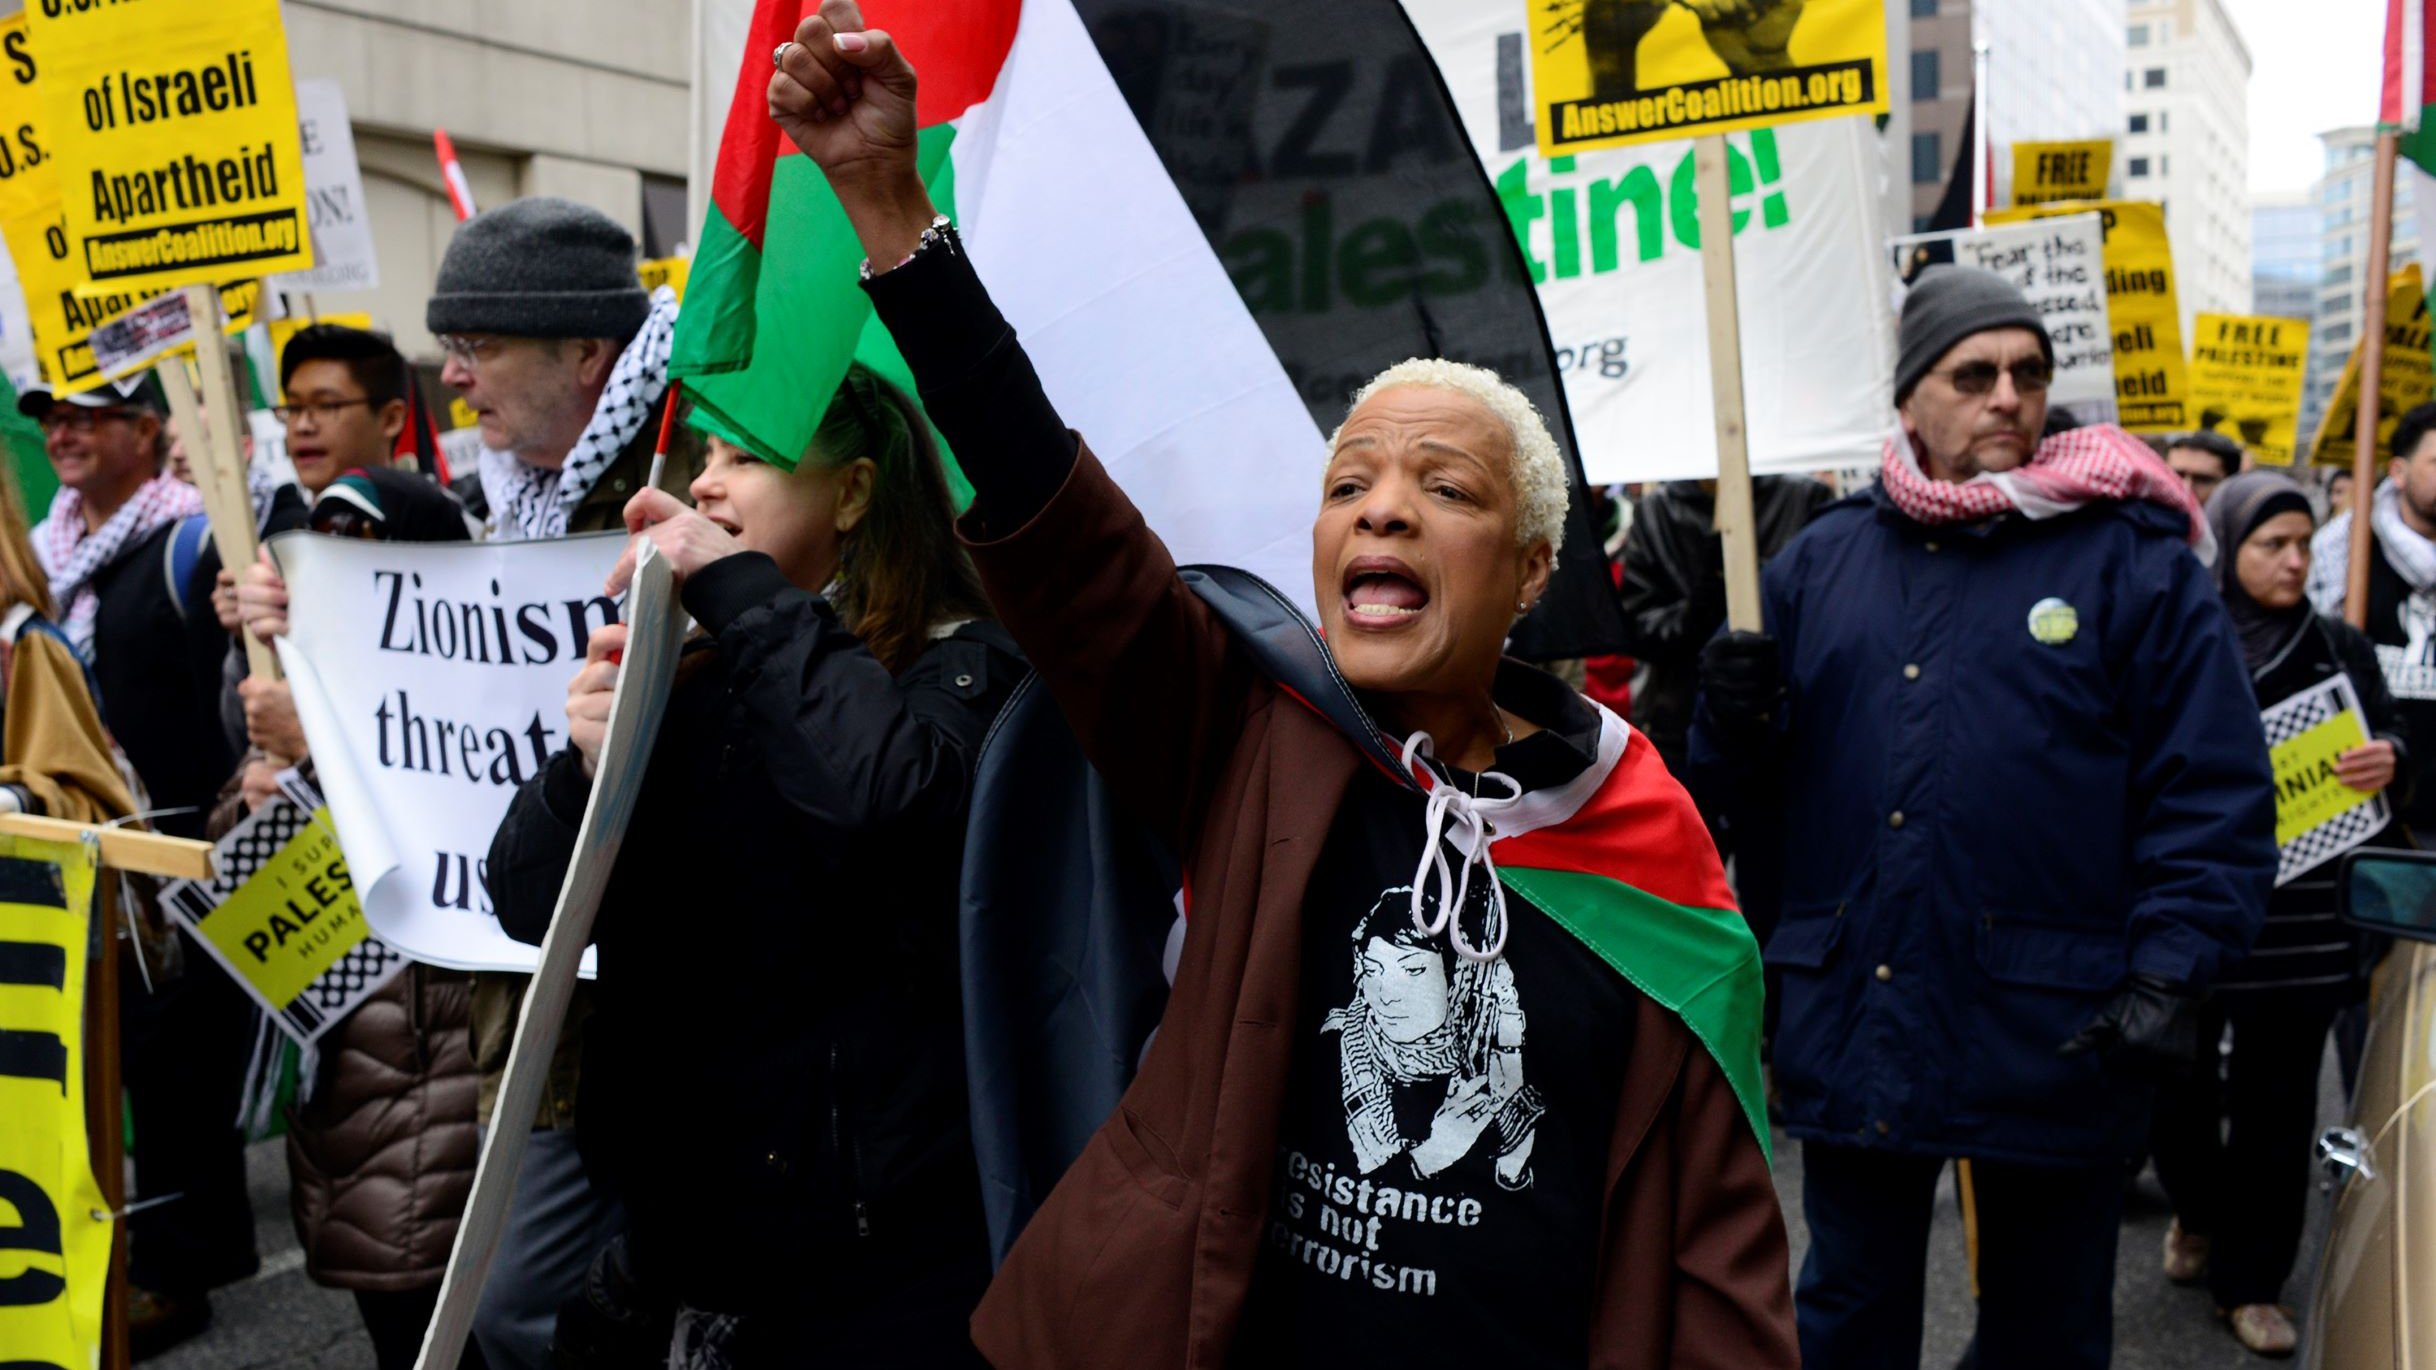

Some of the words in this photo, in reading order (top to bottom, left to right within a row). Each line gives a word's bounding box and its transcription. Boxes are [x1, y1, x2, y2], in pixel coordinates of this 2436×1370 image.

[84, 76, 115, 132] of
[121, 51, 257, 125] Israeli
[1562, 66, 1863, 139] AnswerCoalition.org
[91, 143, 278, 224] Apartheid
[2036, 151, 2091, 185] FREE
[88, 217, 297, 273] AnswerCoalition.org
[2218, 320, 2281, 346] FREE
[243, 857, 354, 964] PALES
[1282, 1146, 1483, 1227] esistance
[1270, 1220, 1437, 1296] errorism
[1321, 1202, 1382, 1251] not
